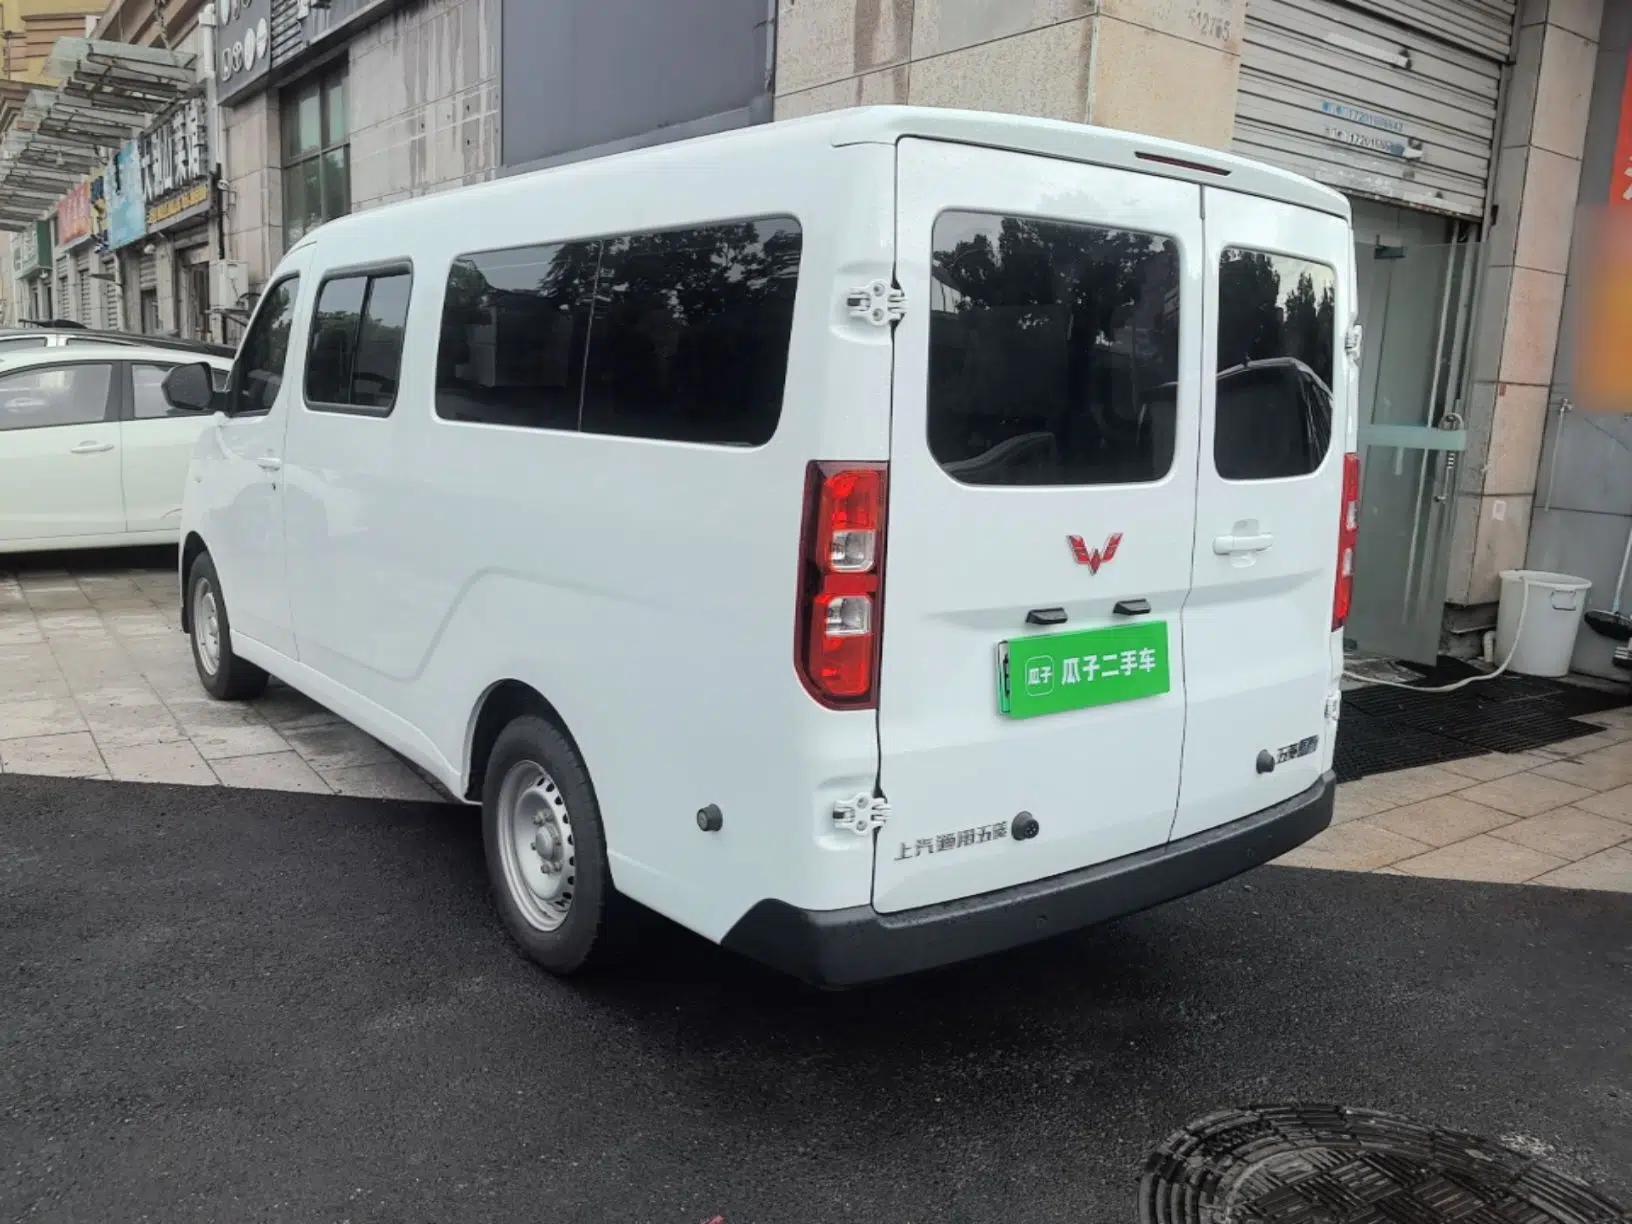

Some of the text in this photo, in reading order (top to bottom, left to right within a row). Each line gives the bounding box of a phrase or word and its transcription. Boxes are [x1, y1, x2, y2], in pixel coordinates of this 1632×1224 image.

[894, 821, 1008, 861] 上汽通用五菱
